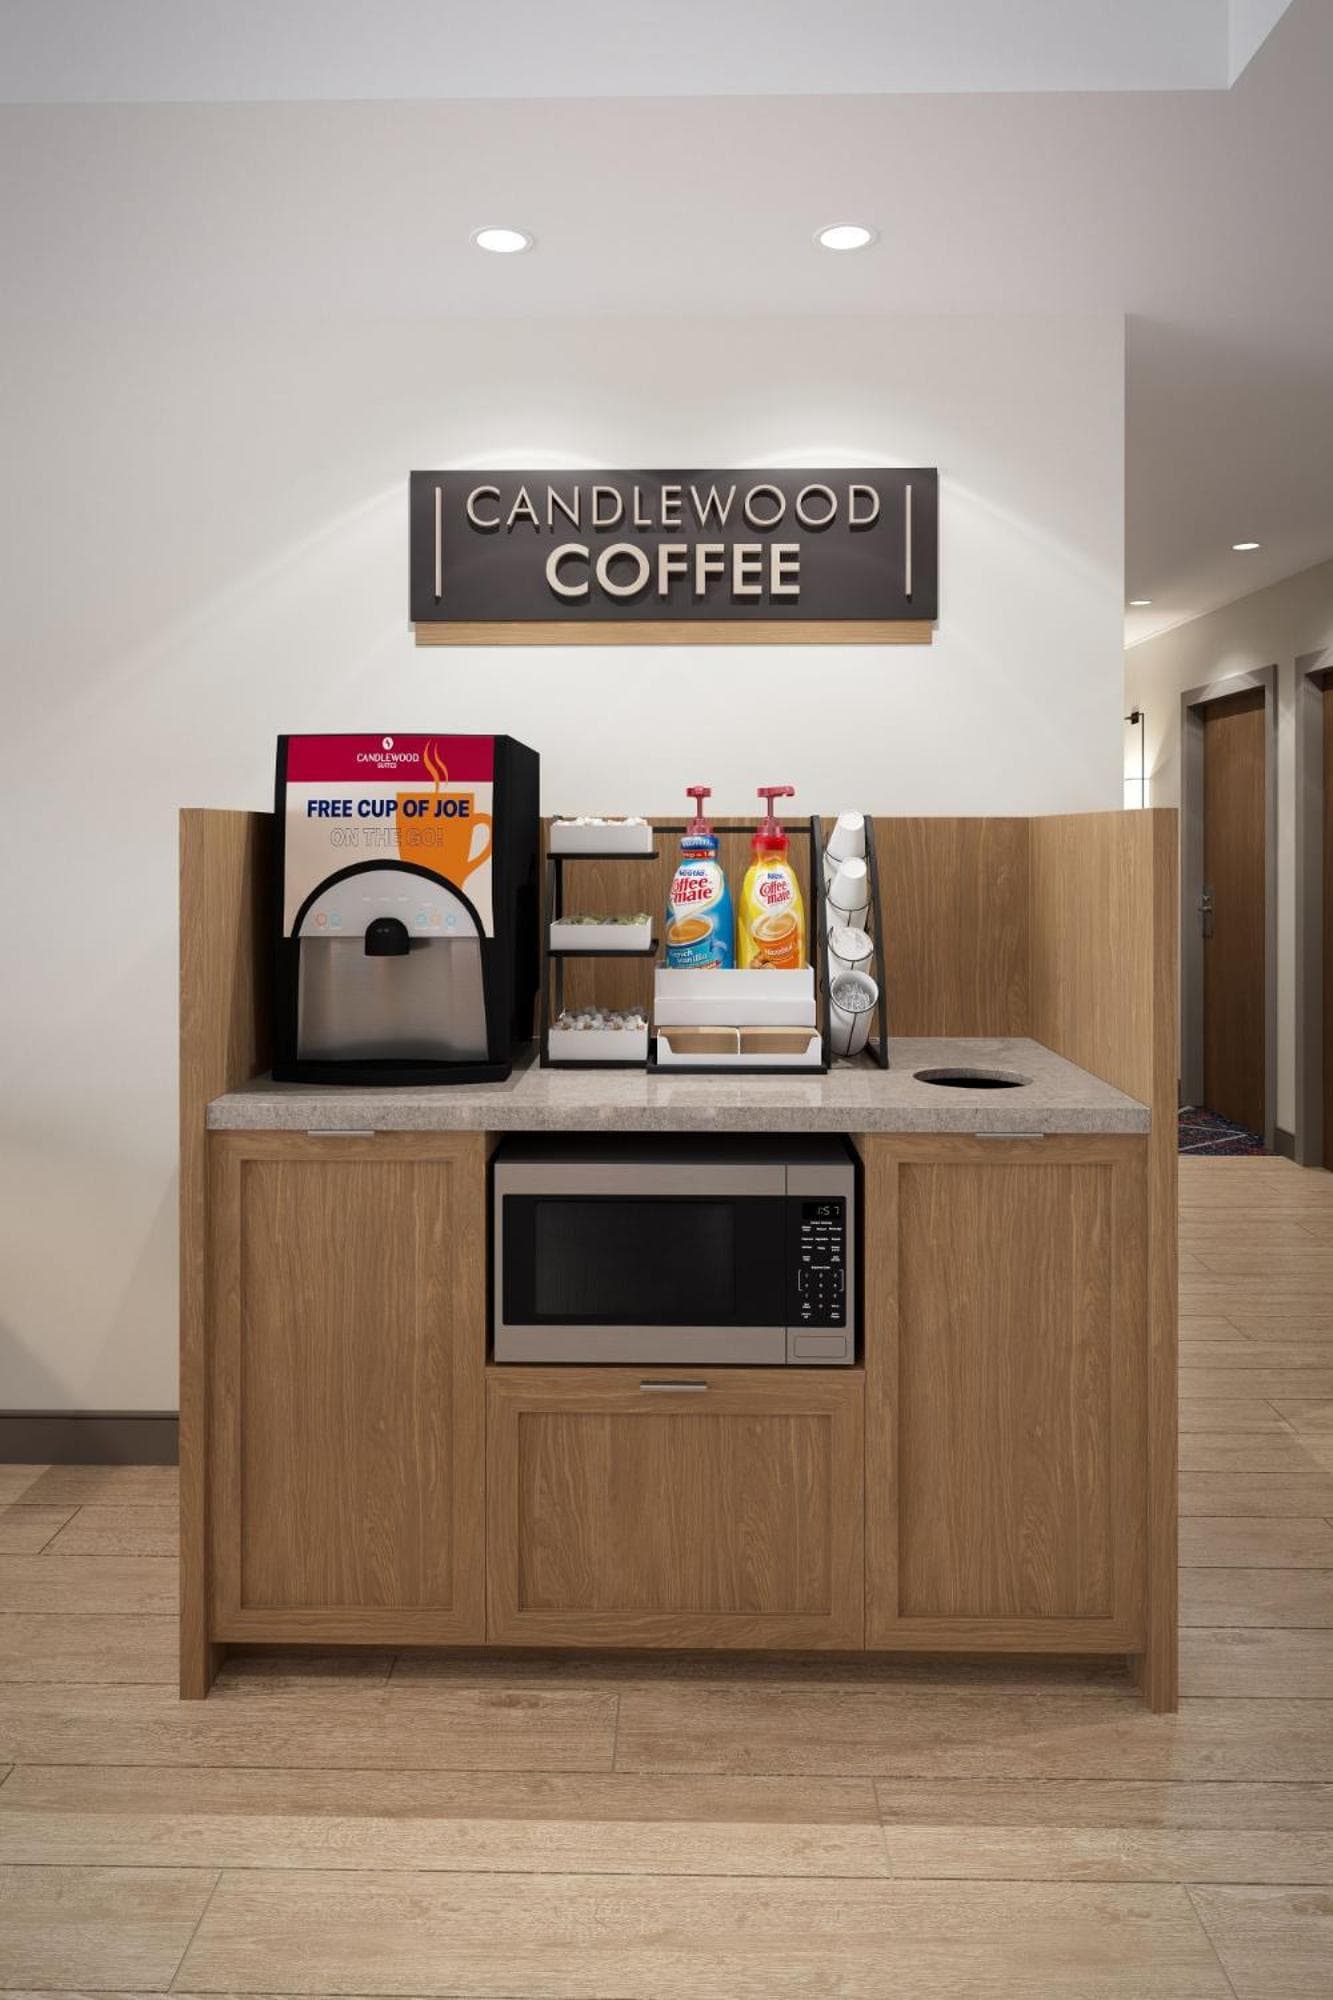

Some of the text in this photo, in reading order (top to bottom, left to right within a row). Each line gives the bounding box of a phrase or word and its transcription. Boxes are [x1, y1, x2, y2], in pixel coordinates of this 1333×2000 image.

[466, 484, 881, 530] CANDLEWOOD
[545, 542, 801, 598] COFFEE
[356, 752, 420, 762] CANDLEWOOD
[307, 799, 470, 818] FREE CUP OF JOE
[330, 827, 445, 848] ON THE GO!
